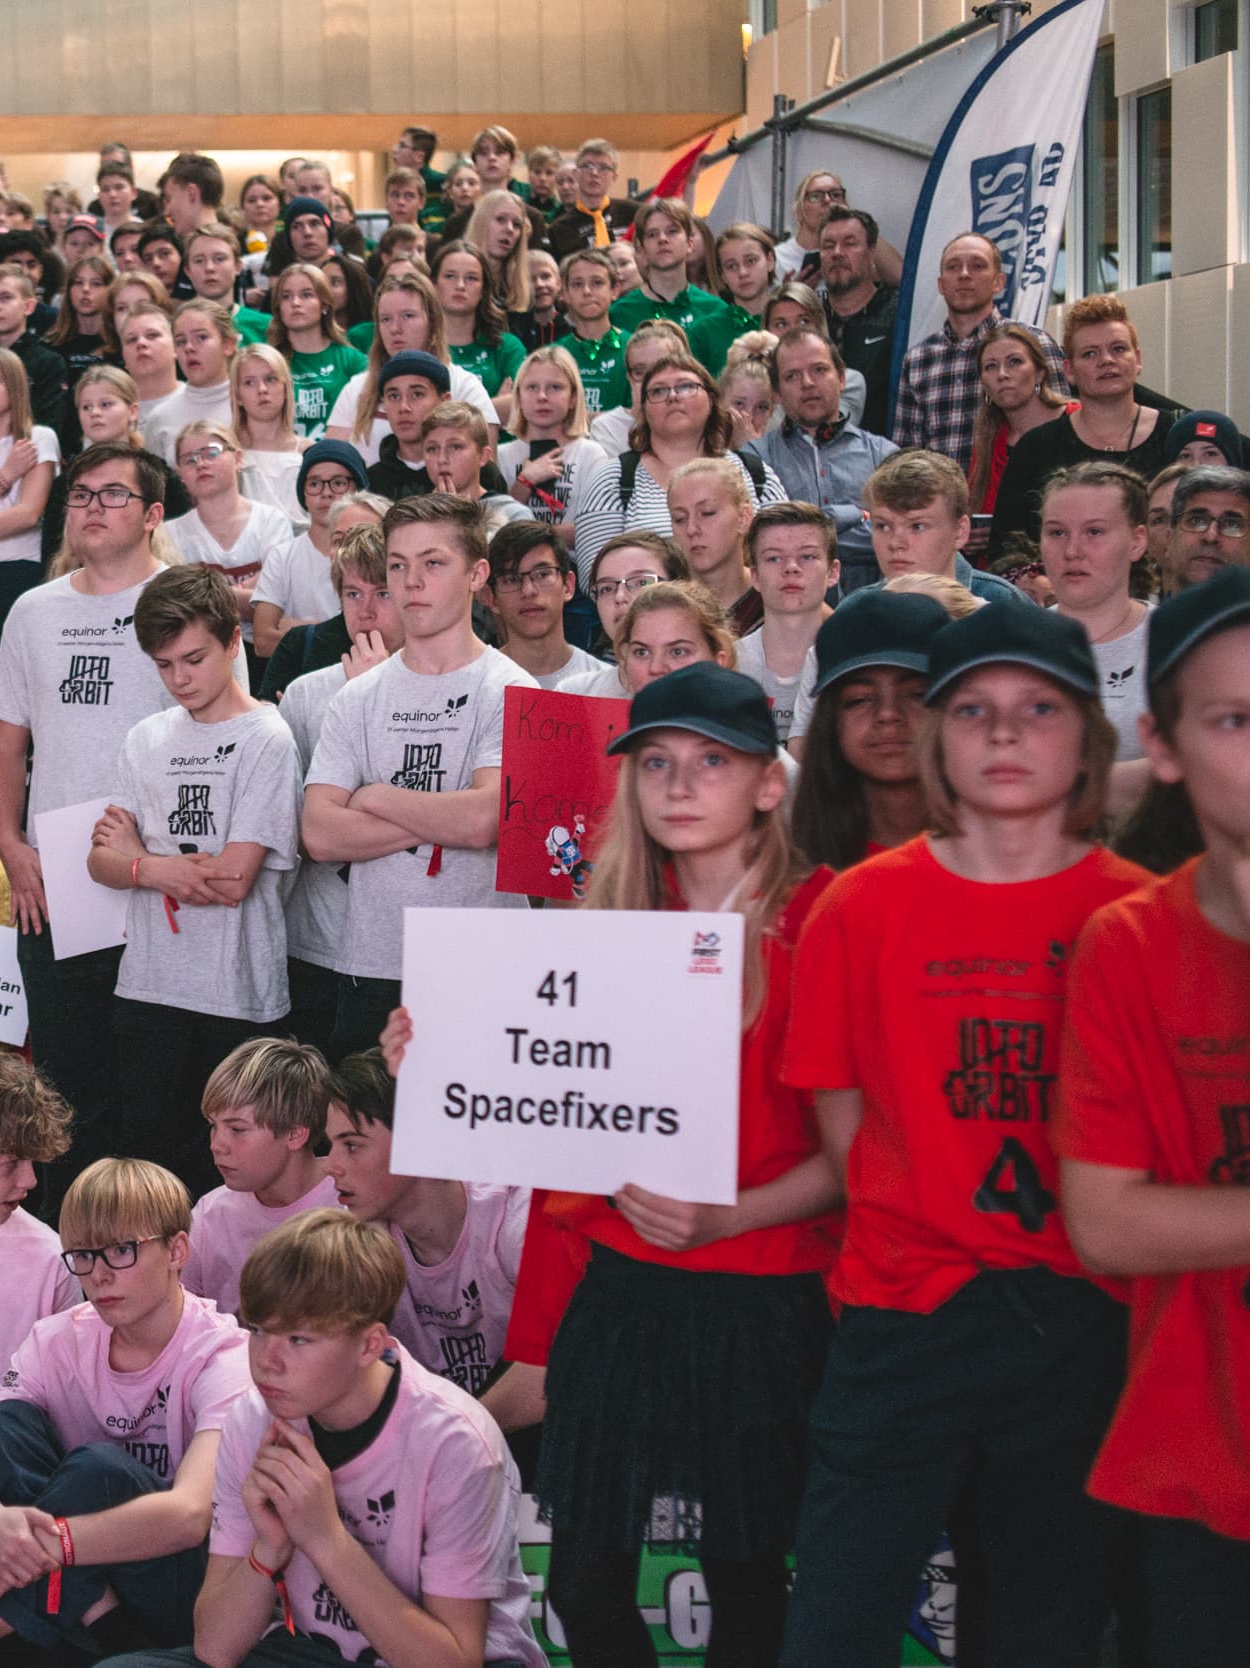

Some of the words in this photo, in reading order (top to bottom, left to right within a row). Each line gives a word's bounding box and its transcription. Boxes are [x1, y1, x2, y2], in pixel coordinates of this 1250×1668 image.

[61, 626, 108, 638] equinor
[392, 710, 442, 723] equinor
[170, 756, 211, 767] equinor
[536, 969, 579, 1008] 41
[504, 1028, 612, 1070] Team
[443, 1082, 681, 1137] Spacefixers
[971, 1135, 1058, 1234] 4
